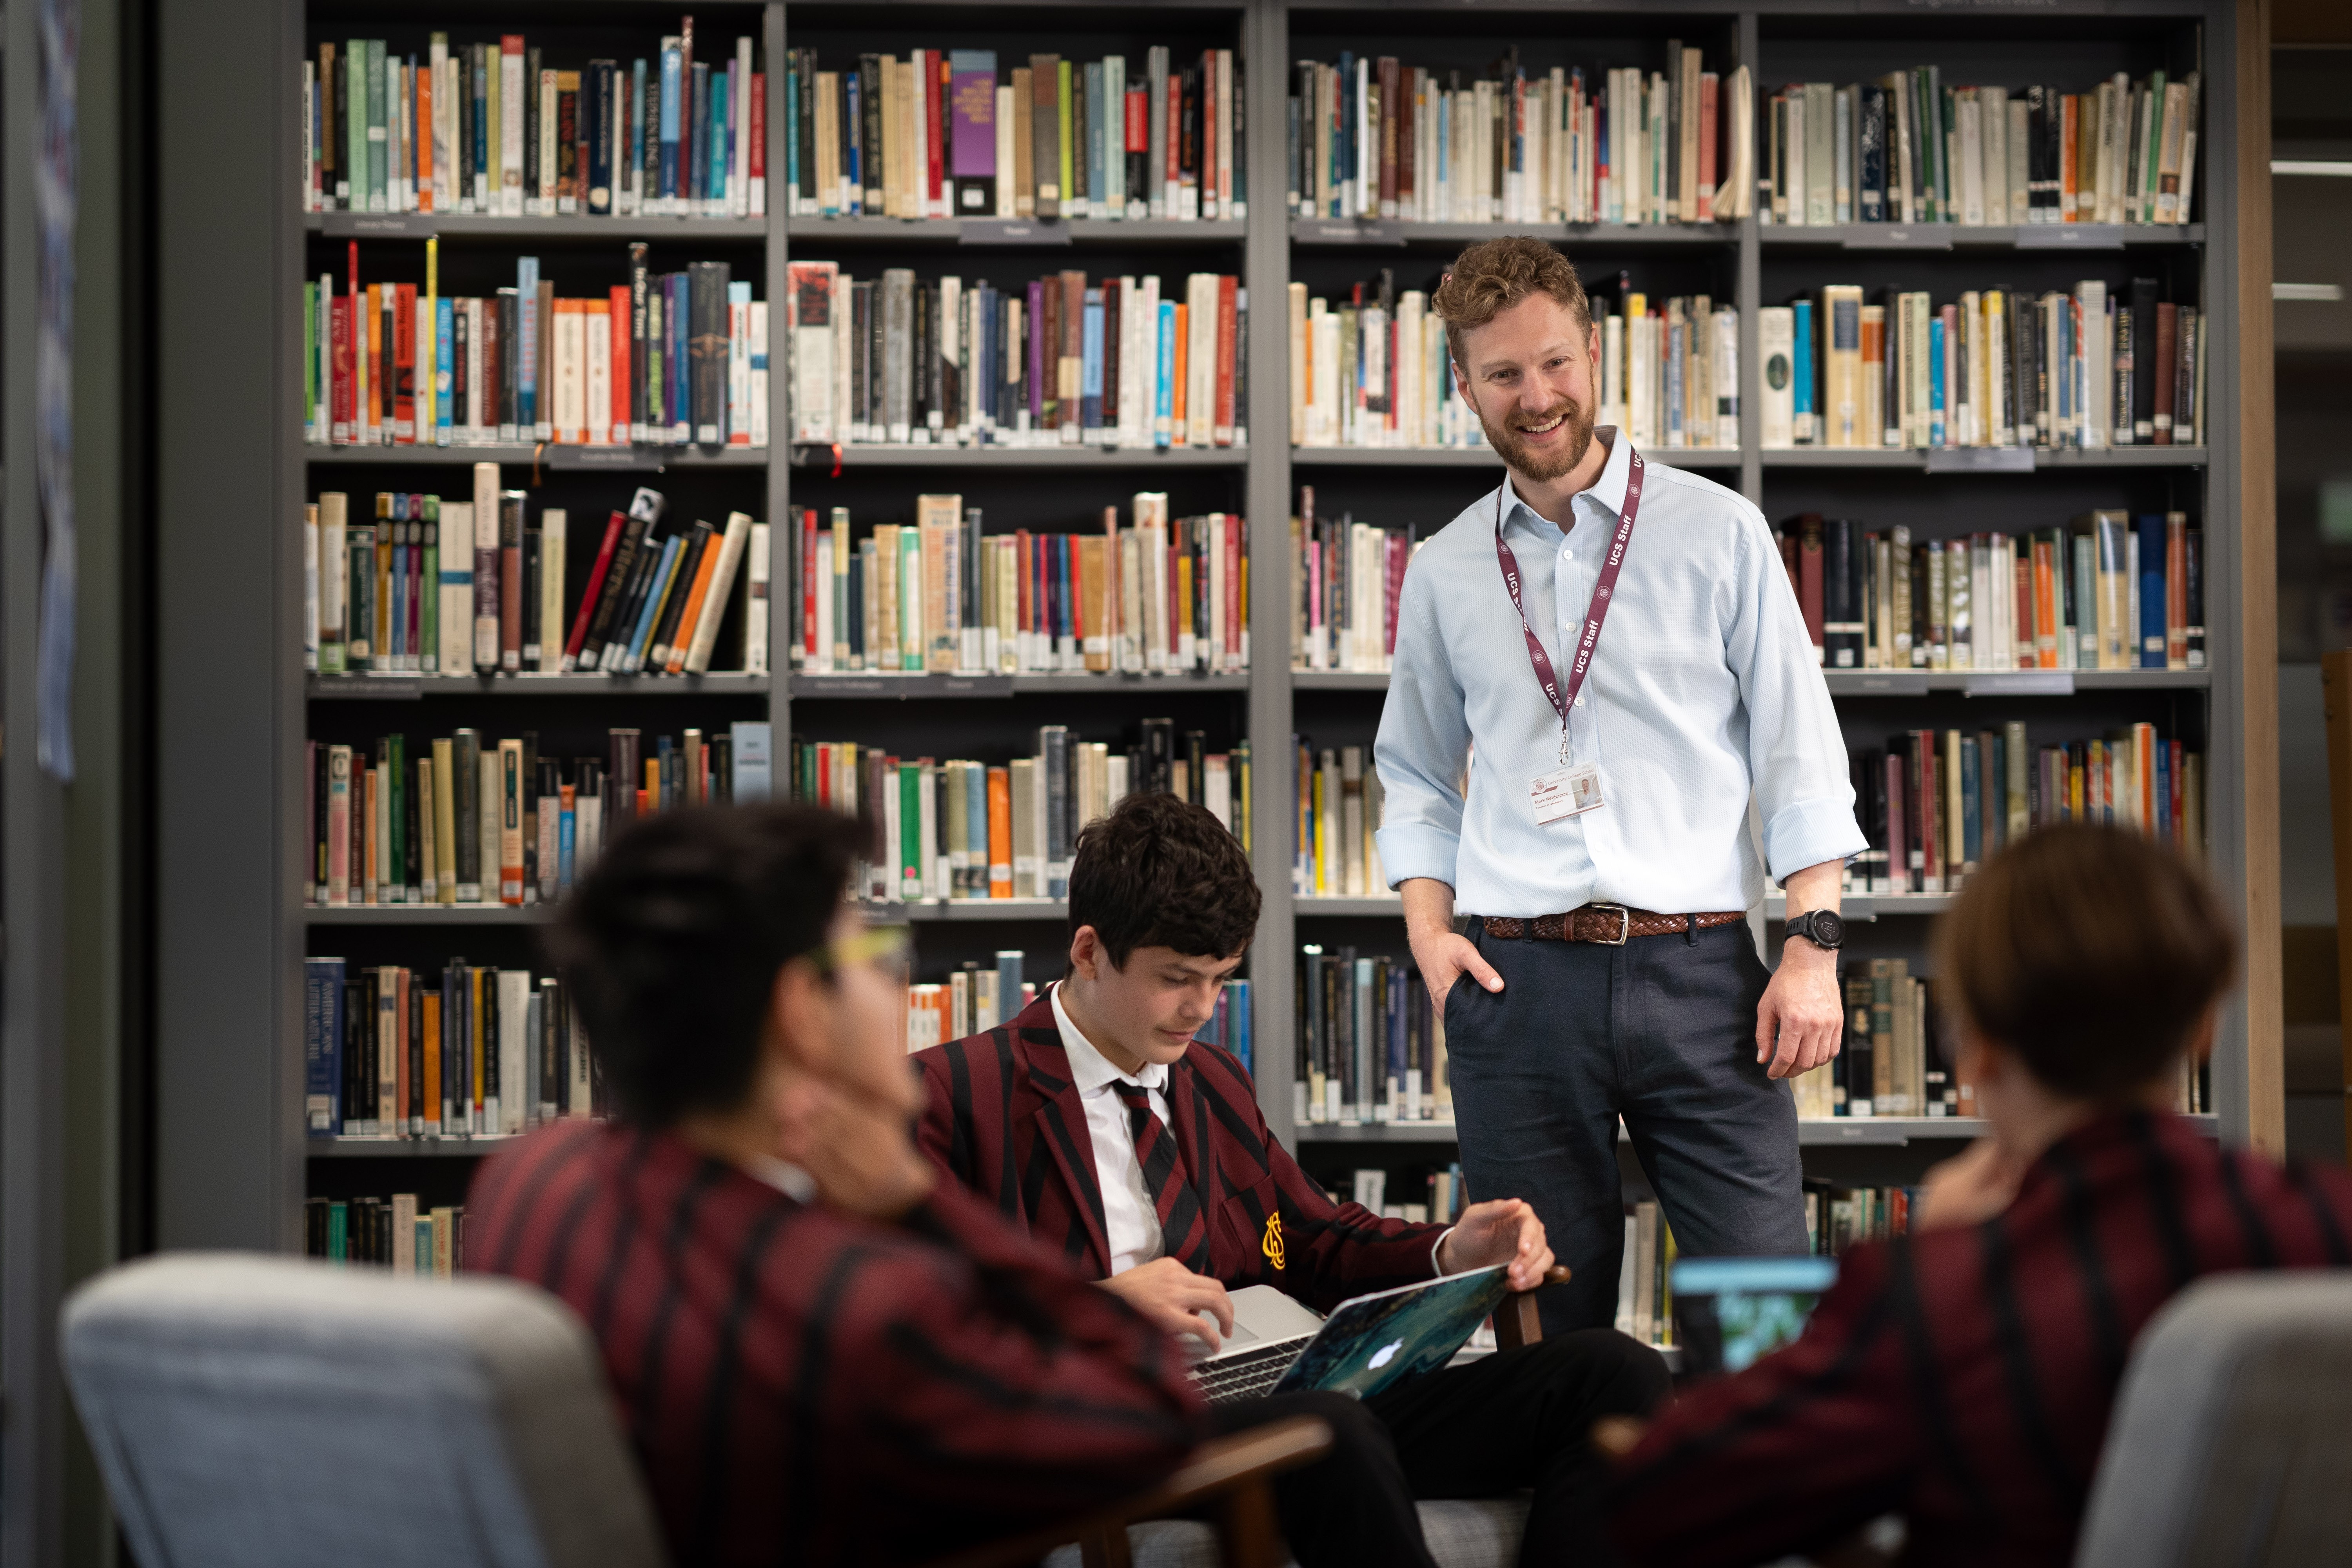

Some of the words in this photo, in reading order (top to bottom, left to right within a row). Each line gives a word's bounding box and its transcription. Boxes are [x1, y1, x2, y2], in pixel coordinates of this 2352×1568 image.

[1609, 543, 1623, 566] UCS
[1618, 514, 1632, 541] Staff
[1507, 572, 1518, 595] UCS
[1575, 650, 1589, 673] UCS
[1584, 619, 1598, 648] Staff
[1546, 683, 1560, 706] UCS
